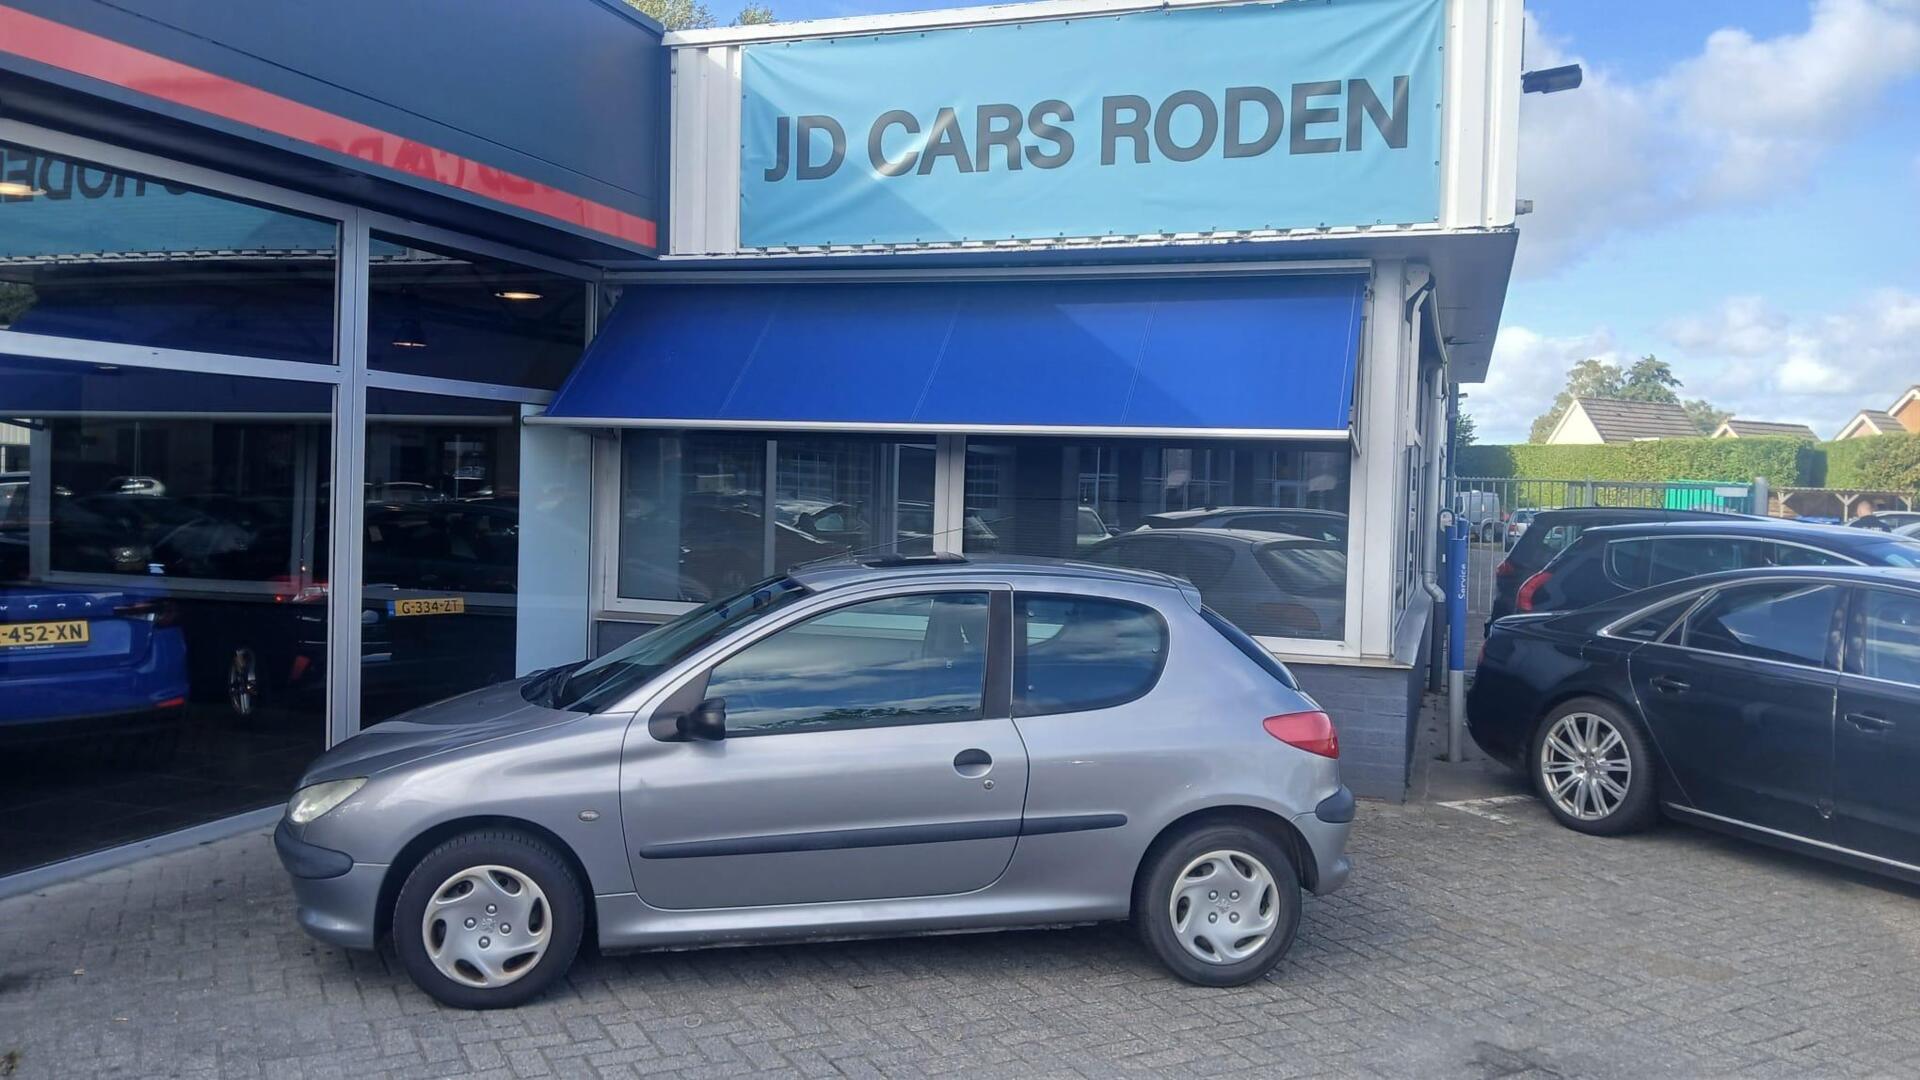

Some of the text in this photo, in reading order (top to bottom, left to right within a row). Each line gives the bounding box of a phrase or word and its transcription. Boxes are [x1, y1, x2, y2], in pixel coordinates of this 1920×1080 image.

[764, 75, 1409, 182] JD CARS RODEN
[1457, 563, 1467, 600] Service
[401, 600, 459, 615] G-334-ZT
[0, 624, 82, 643] -452-XN
